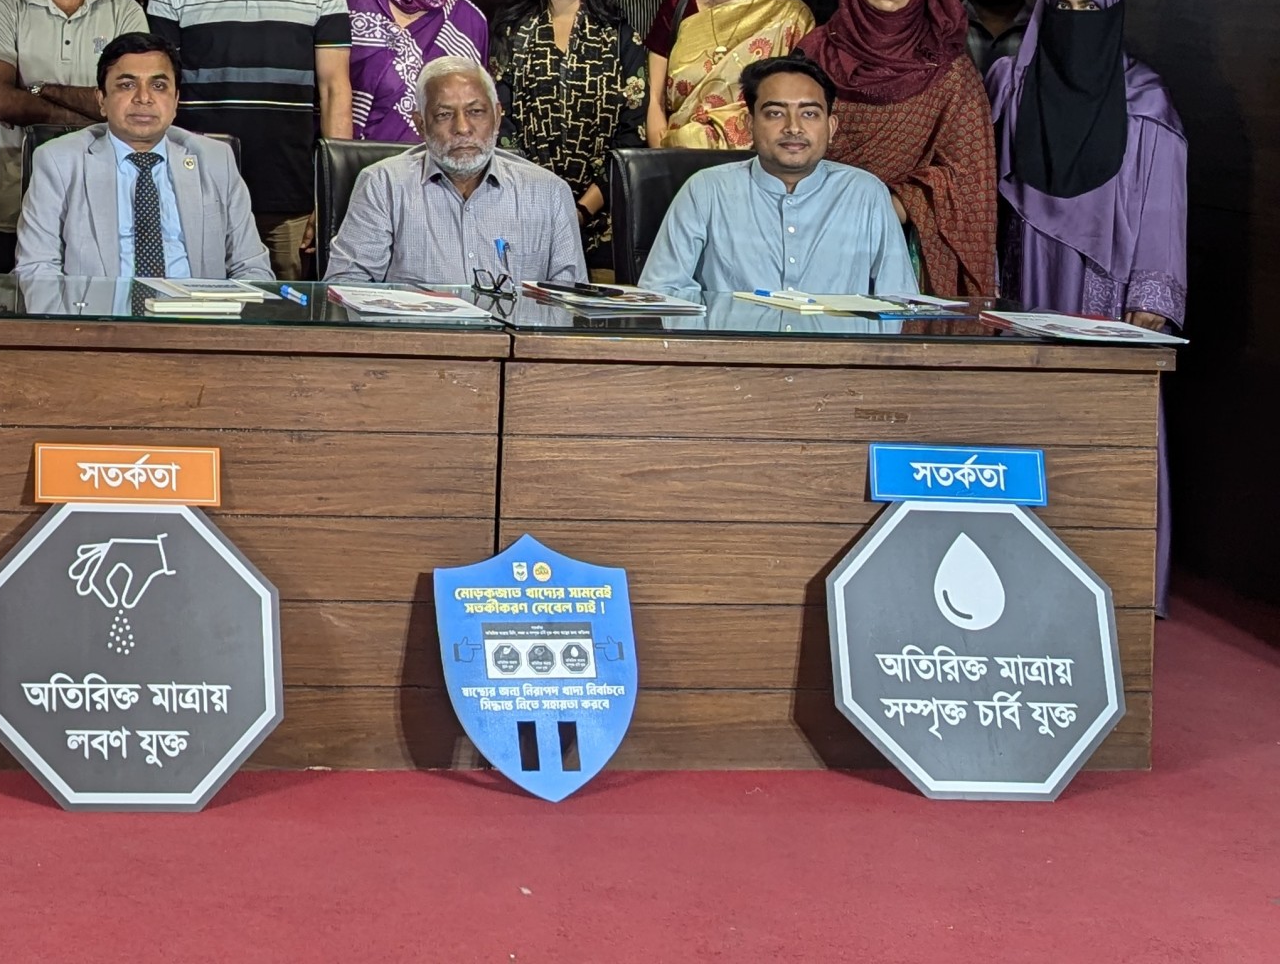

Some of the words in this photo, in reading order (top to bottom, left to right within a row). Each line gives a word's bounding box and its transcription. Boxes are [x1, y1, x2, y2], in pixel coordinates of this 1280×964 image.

[77, 454, 180, 491] সতর্কতা
[910, 455, 1008, 491] সতর্কতা
[532, 602, 572, 615] লেবেল
[576, 600, 596, 613] চাই
[567, 585, 612, 599] সামনেই
[874, 644, 988, 683] অতিরিক্ত
[994, 654, 1075, 686] মাত্রায়
[21, 672, 142, 713] অতিরিক্ত
[147, 681, 232, 714] মাত্রায়
[498, 687, 520, 697] জন্য
[522, 683, 559, 697] নিরাপদ
[586, 682, 625, 696] নির্বাচনে
[516, 697, 539, 711] নিতে
[542, 699, 579, 711] সহায়তা
[580, 699, 610, 710] করবে
[880, 696, 968, 740] সম্পৃক্ত
[973, 691, 1022, 731] চর্বি
[1026, 701, 1078, 737] যুক্ত
[65, 726, 131, 760] লবণ
[135, 729, 190, 768] যুক্ত
